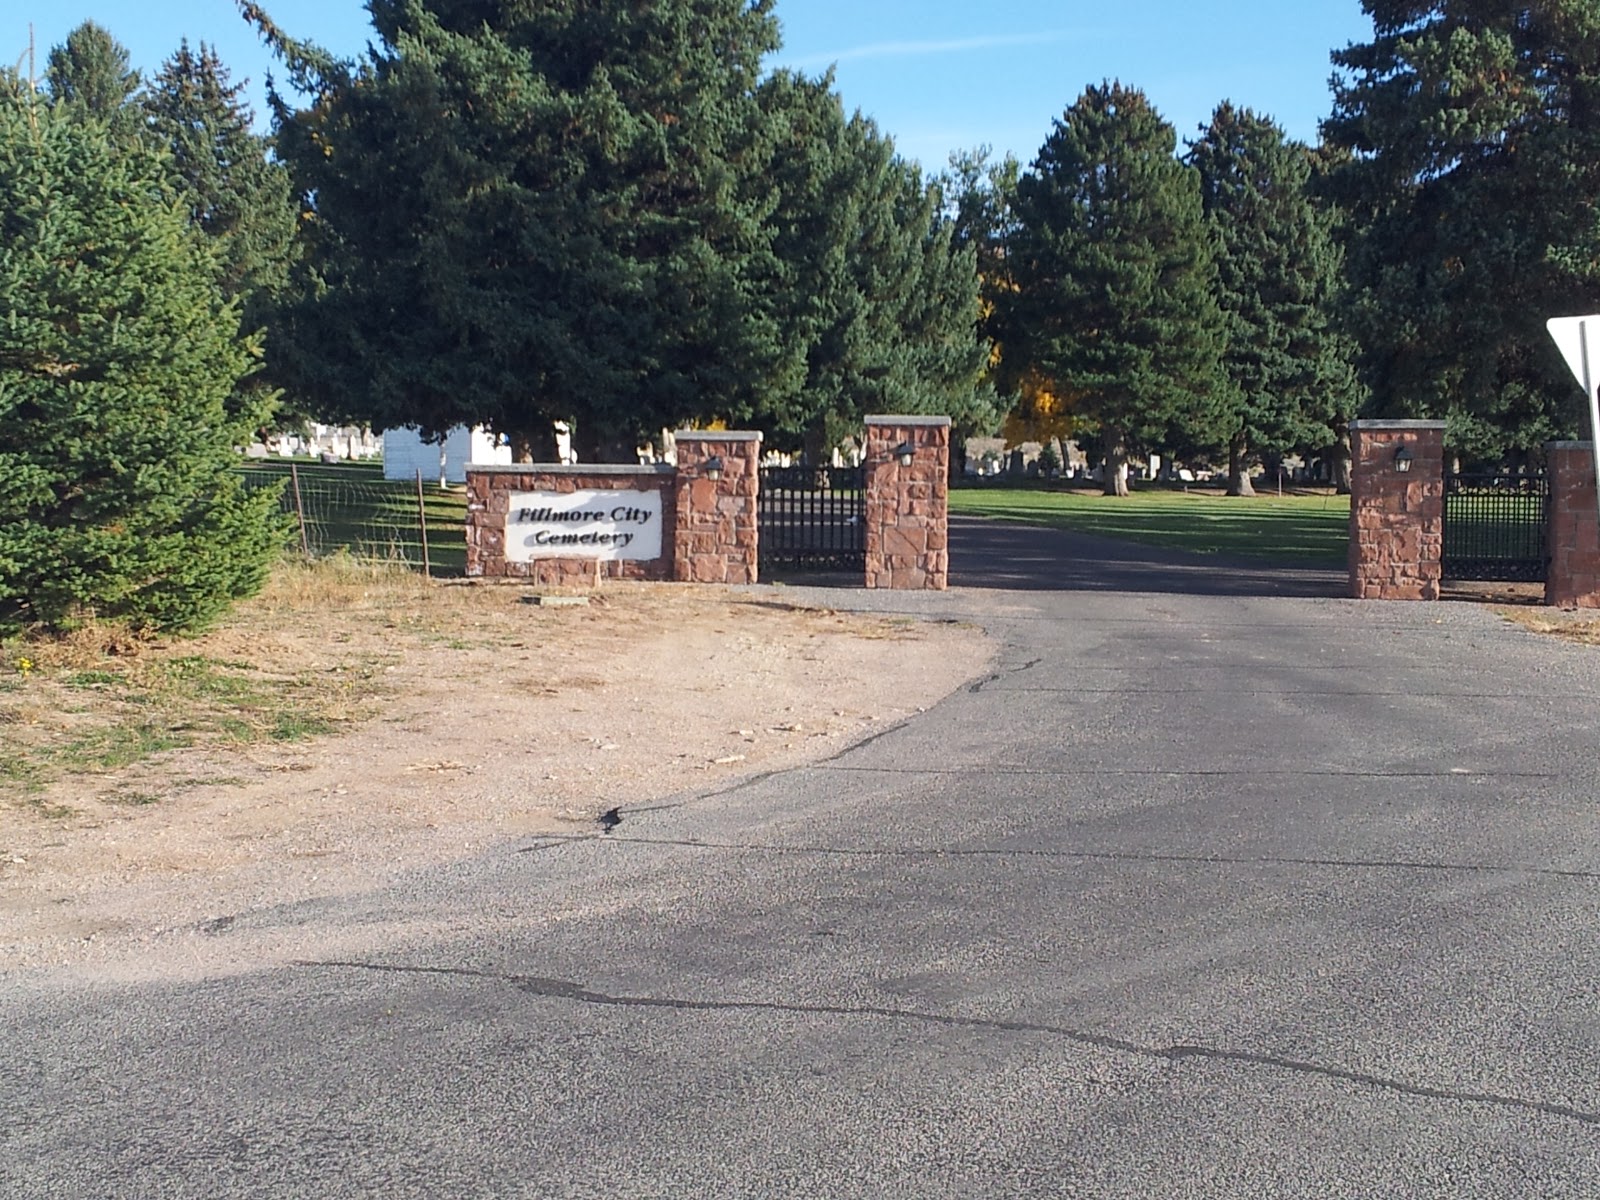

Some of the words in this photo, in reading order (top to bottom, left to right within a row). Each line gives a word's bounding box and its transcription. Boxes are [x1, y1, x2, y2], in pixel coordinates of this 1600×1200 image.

[517, 507, 605, 522] Fillmore
[610, 506, 652, 525] City
[535, 530, 634, 547] Cemetery
